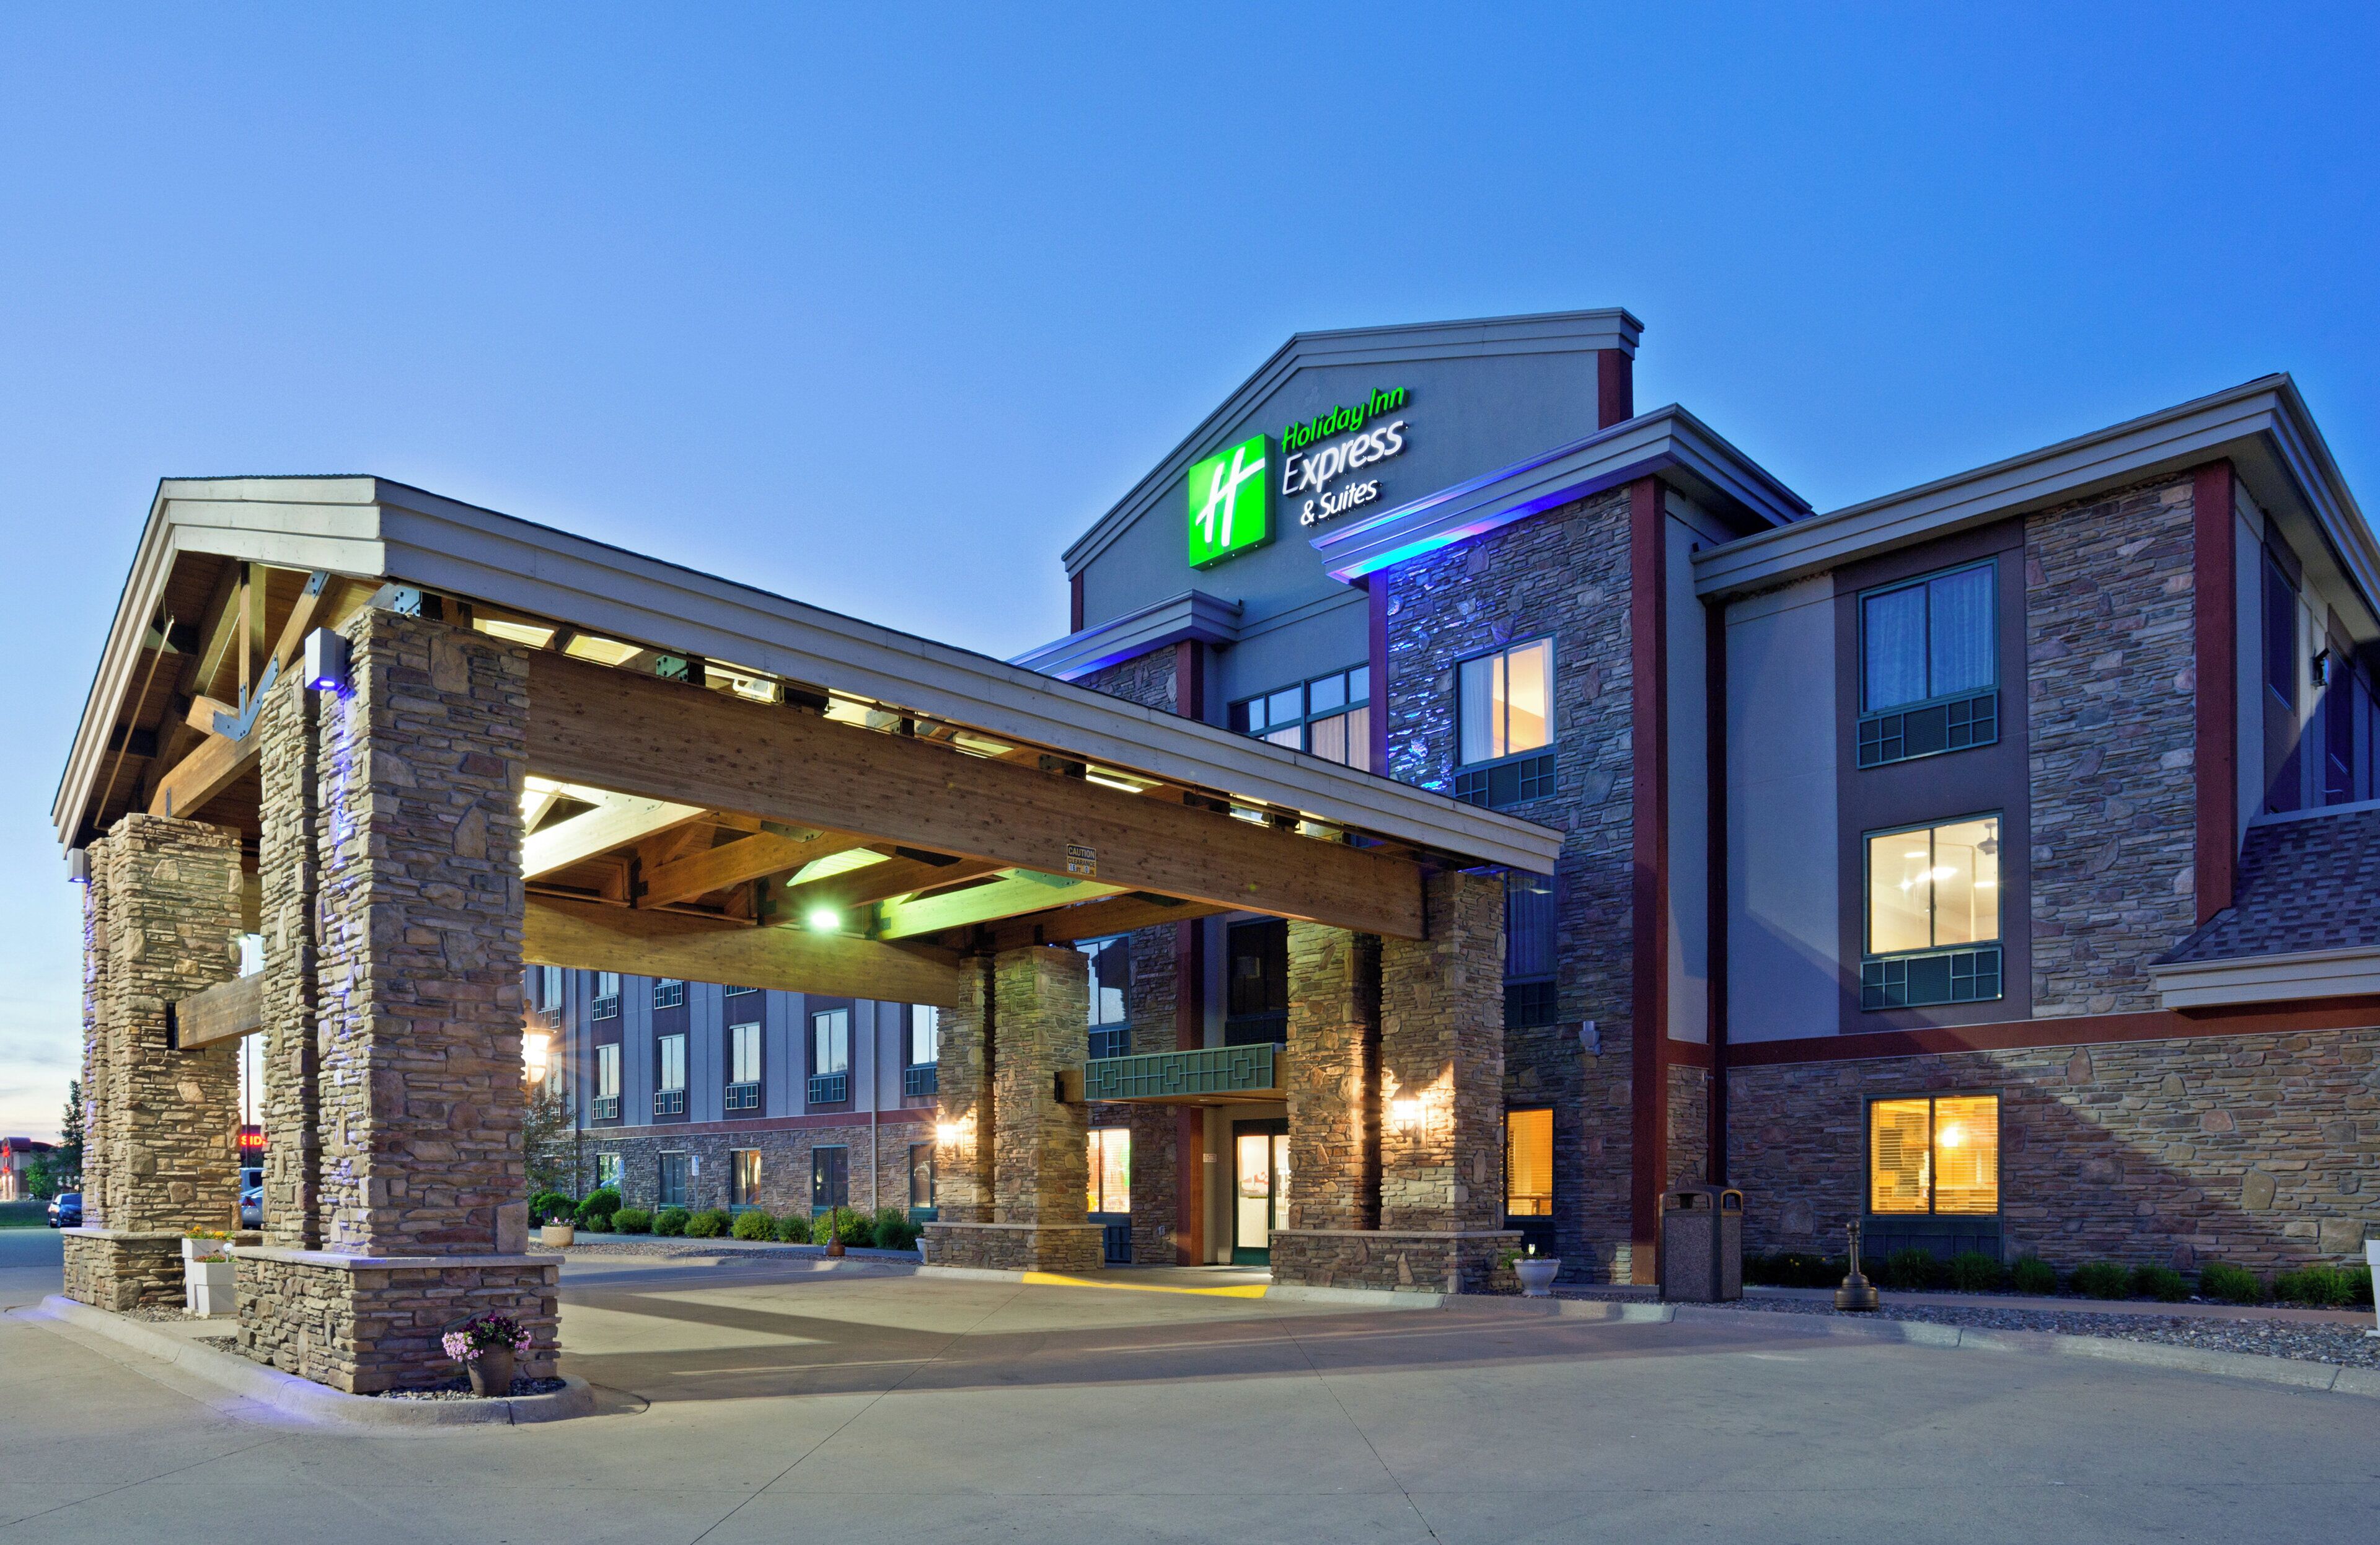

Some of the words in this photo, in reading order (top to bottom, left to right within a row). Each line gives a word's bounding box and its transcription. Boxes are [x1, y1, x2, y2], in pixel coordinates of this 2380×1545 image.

[1281, 403, 1365, 454] Holiday
[1368, 386, 1405, 417] Inn
[1282, 420, 1404, 495] Express
[1300, 500, 1315, 526] &
[1318, 480, 1378, 519] Suites
[1068, 858, 1095, 868] CLEARANCE
[1069, 847, 1095, 859] CAUTION
